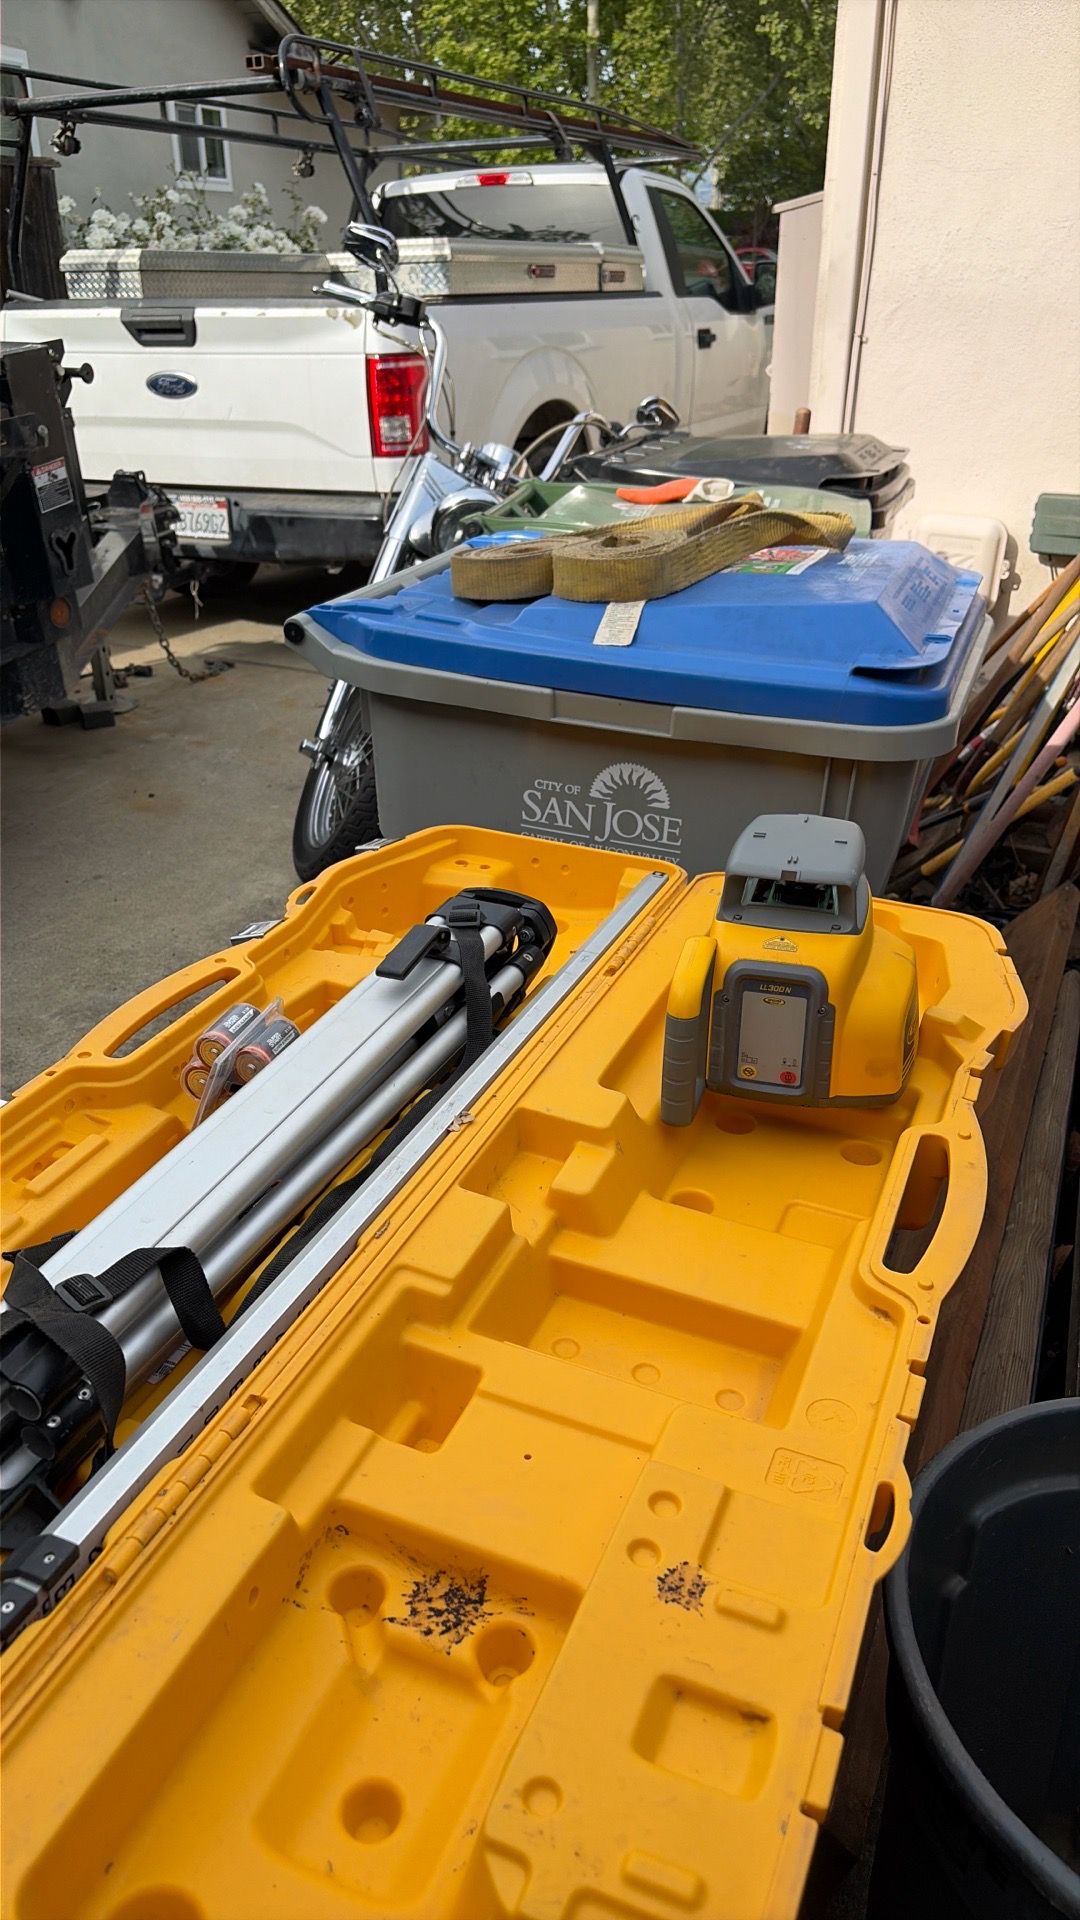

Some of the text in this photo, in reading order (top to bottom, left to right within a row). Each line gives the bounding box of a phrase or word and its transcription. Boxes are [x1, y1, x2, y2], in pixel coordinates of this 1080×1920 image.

[535, 779, 581, 795] CITY OF
[521, 789, 683, 846] SAN JOSE
